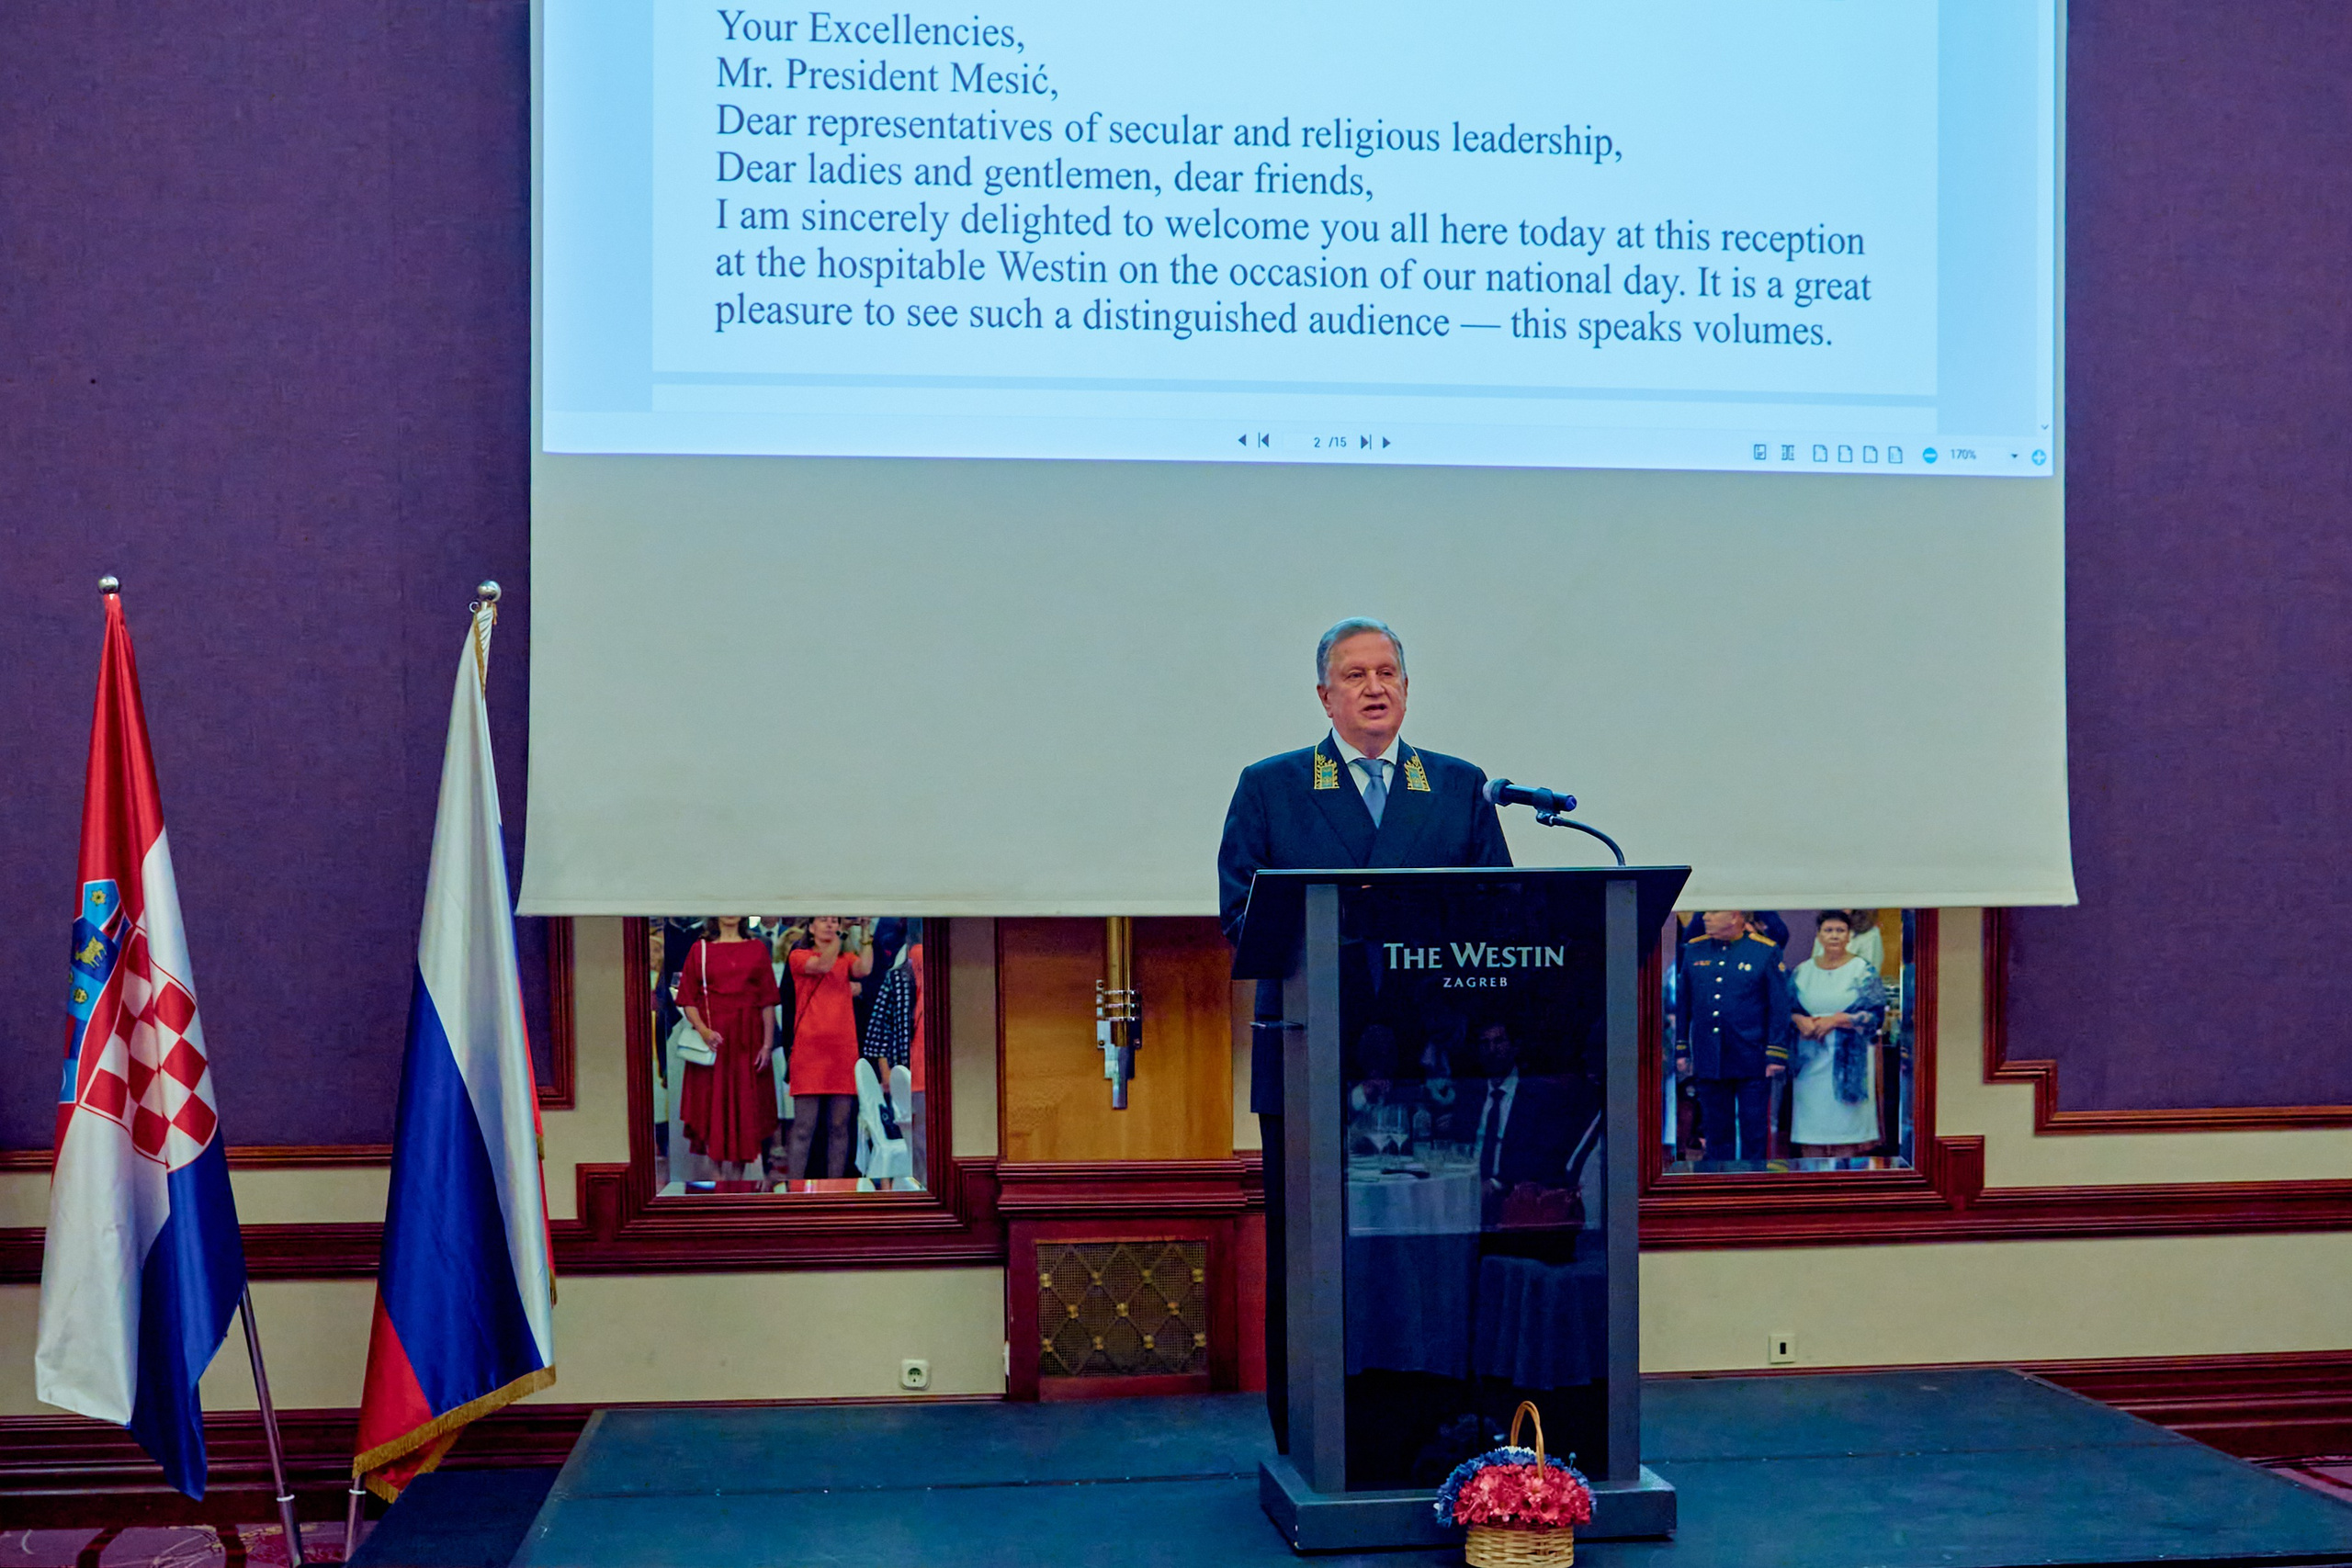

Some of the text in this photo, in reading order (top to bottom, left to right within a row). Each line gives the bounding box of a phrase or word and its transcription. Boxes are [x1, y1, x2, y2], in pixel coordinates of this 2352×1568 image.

[717, 10, 1024, 54] Your Excellencies,
[717, 57, 1057, 101] Mr. President Mesić,
[717, 104, 1622, 164] Dear representatives of secular and religious leadership,
[717, 152, 1373, 202] Dear ladies and gentlemen, dear friends,
[717, 198, 1865, 262] I am sincerely delighted to welcome you all here today at this reception
[716, 245, 1871, 308] at the hospitable Westin on the occasion of our national day. It is a great
[715, 292, 853, 333] pleasure
[864, 299, 895, 326] to
[908, 305, 958, 327] see
[970, 297, 1044, 328] such
[1055, 308, 1072, 329] a
[1083, 299, 1297, 341] distinguished
[1309, 303, 1450, 337] audience
[1510, 308, 1566, 339] this
[1578, 310, 1681, 349] speaks
[1693, 312, 1832, 345] volumes.
[1314, 436, 1347, 448] 2 /15
[1951, 448, 1977, 460] 170%
[1383, 942, 1565, 969] THE WESTIN
[1443, 976, 1508, 988] ZAGREB
